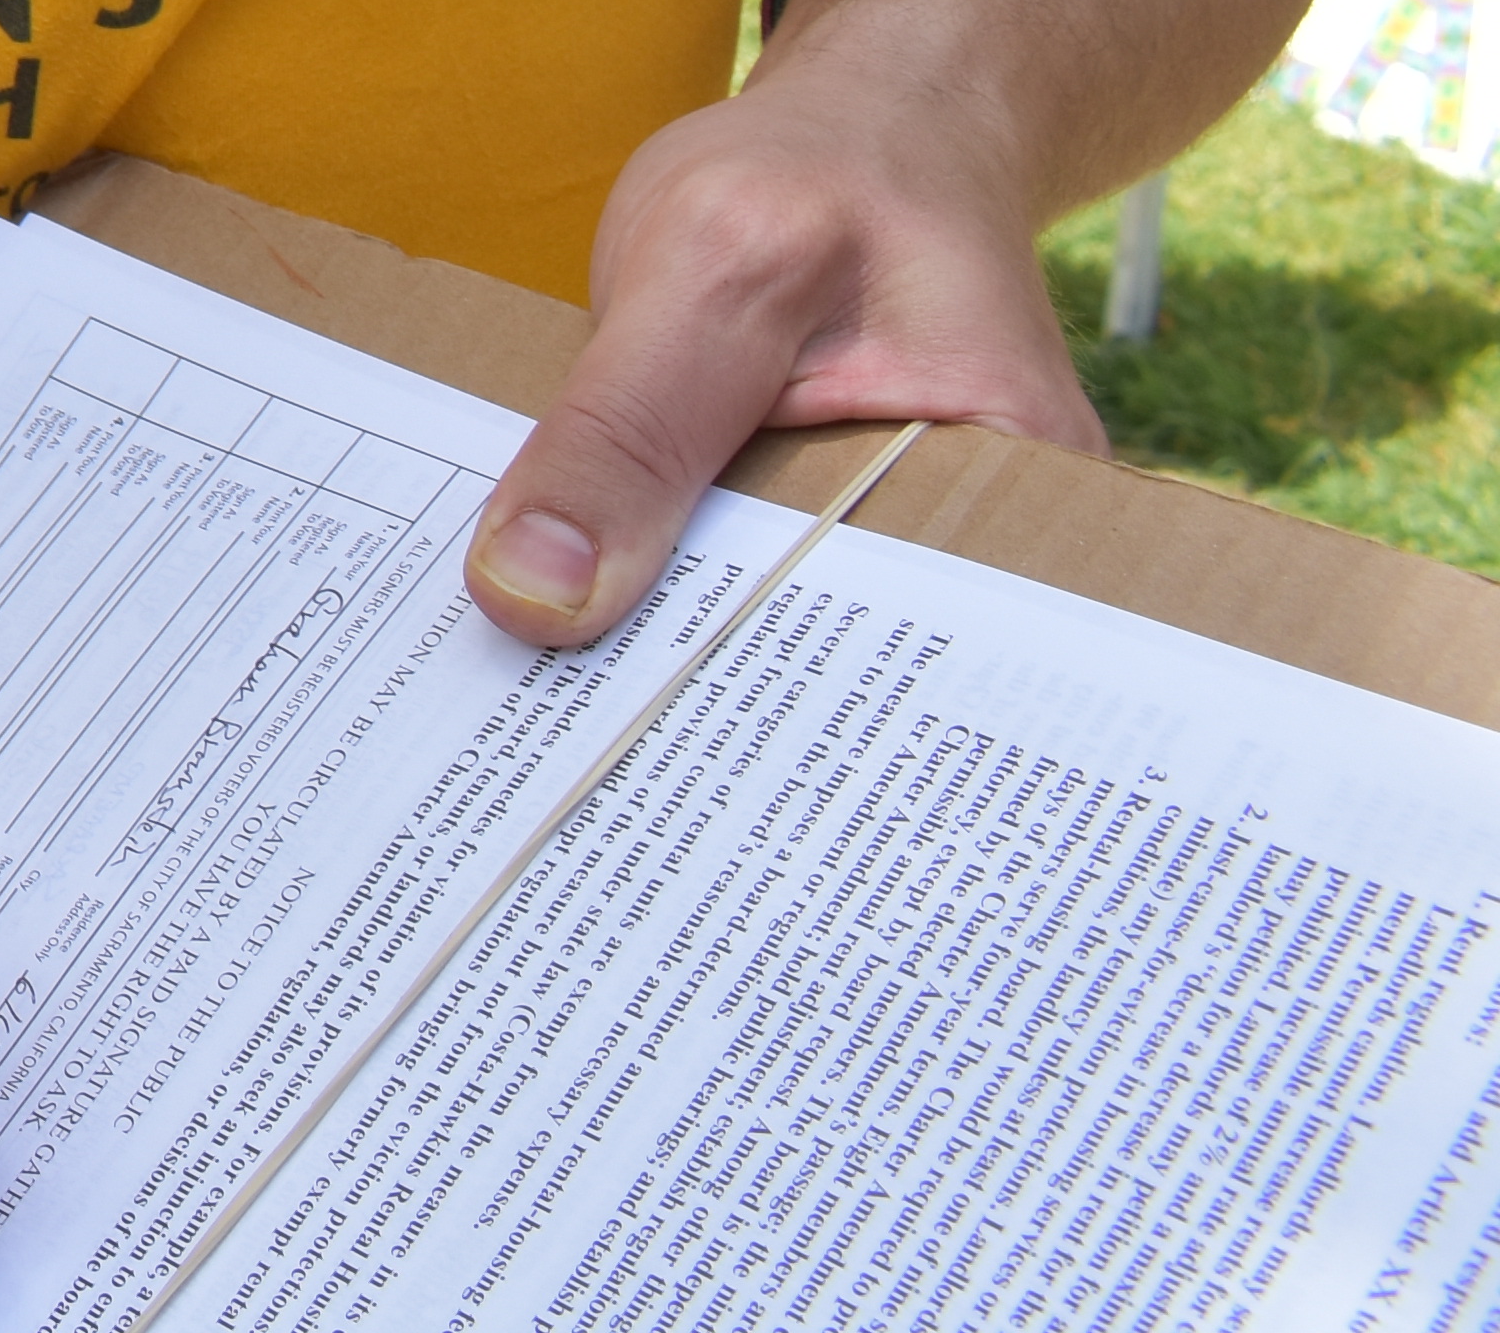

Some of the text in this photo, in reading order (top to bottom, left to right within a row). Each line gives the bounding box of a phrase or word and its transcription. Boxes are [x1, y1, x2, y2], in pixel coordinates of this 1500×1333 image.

[23, 404, 53, 439] To Vote
[23, 408, 65, 460] Registered
[46, 415, 77, 449] Sign As
[77, 425, 102, 454] Name
[90, 430, 114, 454] Print
[75, 455, 96, 476] Your
[109, 447, 154, 497] Registered
[110, 443, 141, 476] To Vote
[133, 453, 166, 485] Sign As
[164, 462, 190, 489] Name
[178, 466, 203, 489] Print
[198, 478, 230, 510] To Vote
[162, 490, 185, 510] Your
[197, 481, 243, 531] Registered
[222, 487, 255, 519] Sign As
[252, 496, 280, 523] Name
[267, 500, 293, 523] Print
[250, 524, 275, 545] Your
[288, 512, 323, 545] To Vote
[288, 516, 335, 566] Registered
[313, 522, 347, 554] Sign As
[345, 531, 374, 559] Name
[361, 535, 387, 559] Print
[405, 535, 432, 558] ALL
[344, 559, 369, 581] Your
[362, 560, 413, 616] SIGNERS
[669, 562, 744, 648] program.
[332, 614, 369, 655] MUST
[875, 618, 914, 662] sure
[315, 653, 338, 673] BE
[858, 665, 884, 686] to
[368, 663, 415, 714] MAY
[254, 672, 324, 752] REGISTERED
[820, 689, 868, 739] fund
[338, 714, 374, 747] BE
[795, 741, 830, 774] the
[213, 753, 262, 806] VOTERS
[199, 806, 219, 827] OF
[234, 748, 346, 889] CIRCULATED
[175, 828, 206, 856] THE
[18, 869, 41, 891] City
[152, 856, 182, 890] CITY
[222, 553, 707, 1184] The measure includes remedies for violation of its provisions. For
[711, 712, 940, 1020] ter Amendment or regulations.
[137, 890, 157, 912] OF
[208, 890, 241, 927] BY
[210, 664, 587, 1147] The board, tenants, or landlords may also seek an
[655, 858, 743, 972] reasonable
[34, 892, 90, 962] Address Only
[59, 898, 104, 953] Residence
[189, 925, 211, 942] A
[17, 803, 277, 1132] YOU HAVE THE RIGHT TO ASK.
[57, 910, 141, 1011] SACRAMENTO,
[150, 947, 199, 1003] PAID
[113, 865, 316, 1134] NOTICE TO THE PUBLIC
[622, 974, 660, 1020] and
[48, 1005, 156, 1142] SIGNATURE
[546, 1020, 629, 1127] necessary
[472, 1129, 552, 1229] expenses.
